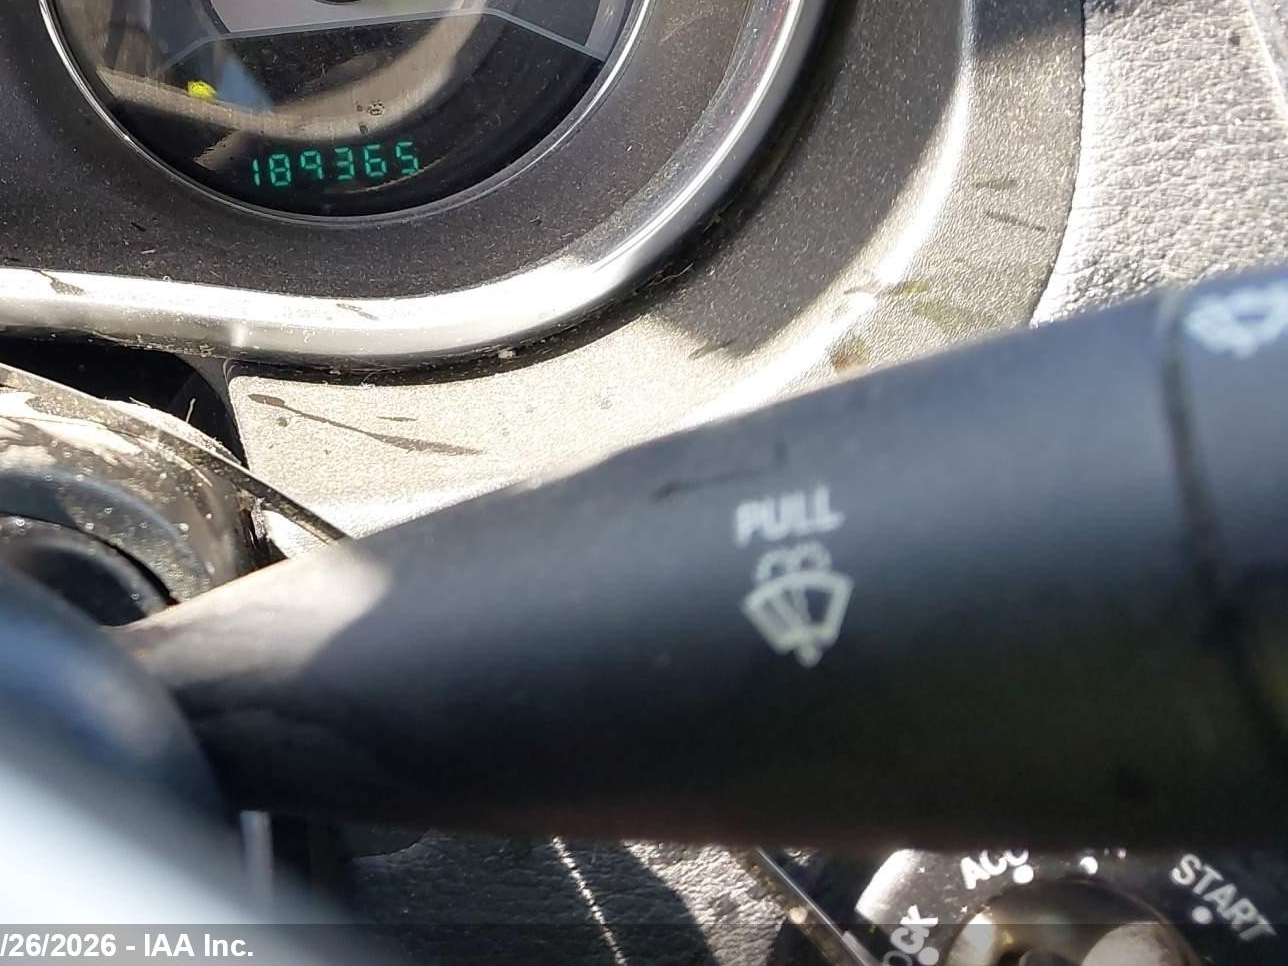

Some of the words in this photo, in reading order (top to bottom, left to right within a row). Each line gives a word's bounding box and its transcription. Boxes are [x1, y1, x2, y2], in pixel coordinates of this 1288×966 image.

[253, 141, 419, 187] 189365
[734, 484, 845, 548] PULL
[1171, 853, 1278, 942] START
